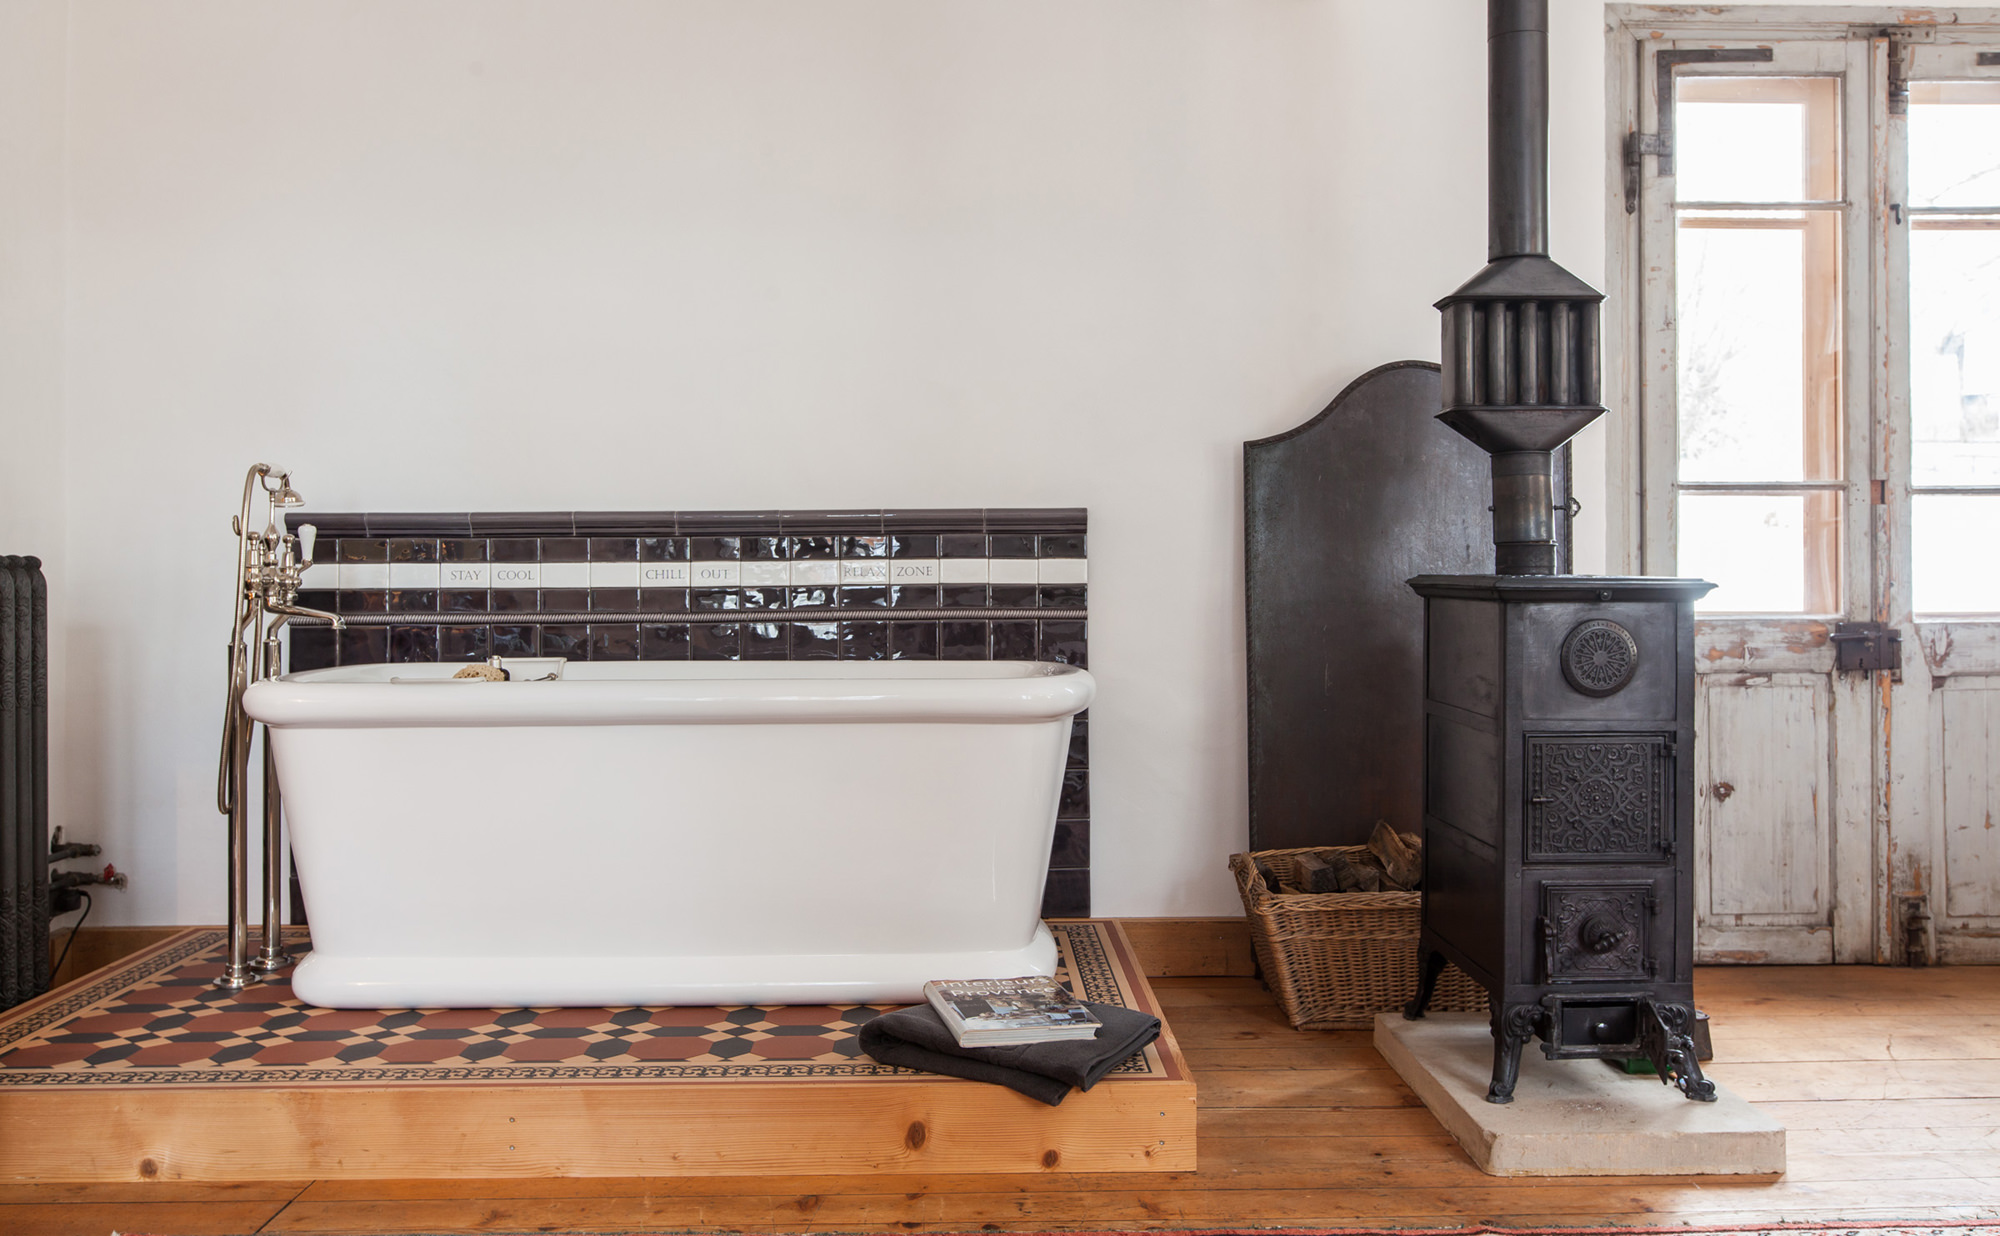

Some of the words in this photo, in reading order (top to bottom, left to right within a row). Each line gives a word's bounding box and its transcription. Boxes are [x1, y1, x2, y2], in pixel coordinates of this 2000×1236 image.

[450, 569, 482, 581] STAY
[497, 569, 535, 581] COOL
[645, 569, 685, 580] CHILL
[700, 568, 730, 580] OUT
[843, 566, 886, 577] RELAX
[896, 566, 933, 577] ZONE
[940, 978, 1050, 988] Interieurs
[950, 987, 1057, 997] Provence
